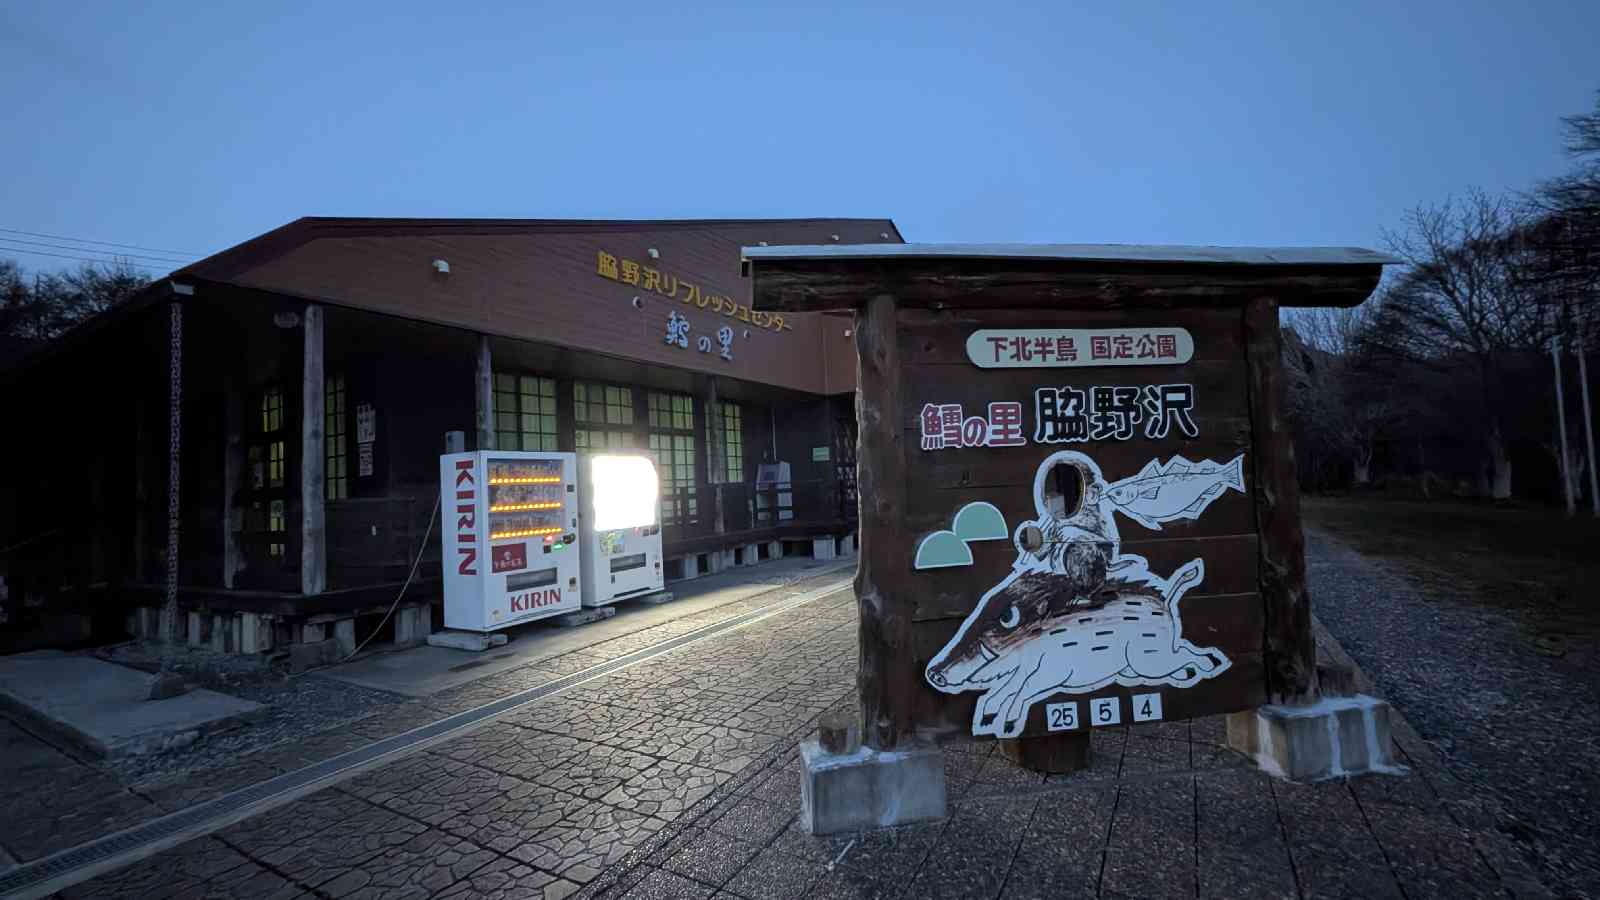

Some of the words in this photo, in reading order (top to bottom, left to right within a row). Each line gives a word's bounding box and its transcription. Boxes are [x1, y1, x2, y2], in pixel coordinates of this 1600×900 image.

[597, 251, 792, 331] 脇野沢リフレッシュセンター
[987, 336, 1077, 361] 下北半島
[1091, 334, 1177, 359] 国定公園
[921, 402, 1026, 450] 鱈の里
[1034, 384, 1198, 442] 脇野沢
[456, 461, 477, 575] KIRIN
[511, 588, 561, 612] KIRIN
[1052, 707, 1074, 728] 25
[1099, 703, 1112, 722] 5
[1141, 699, 1153, 717] 4
